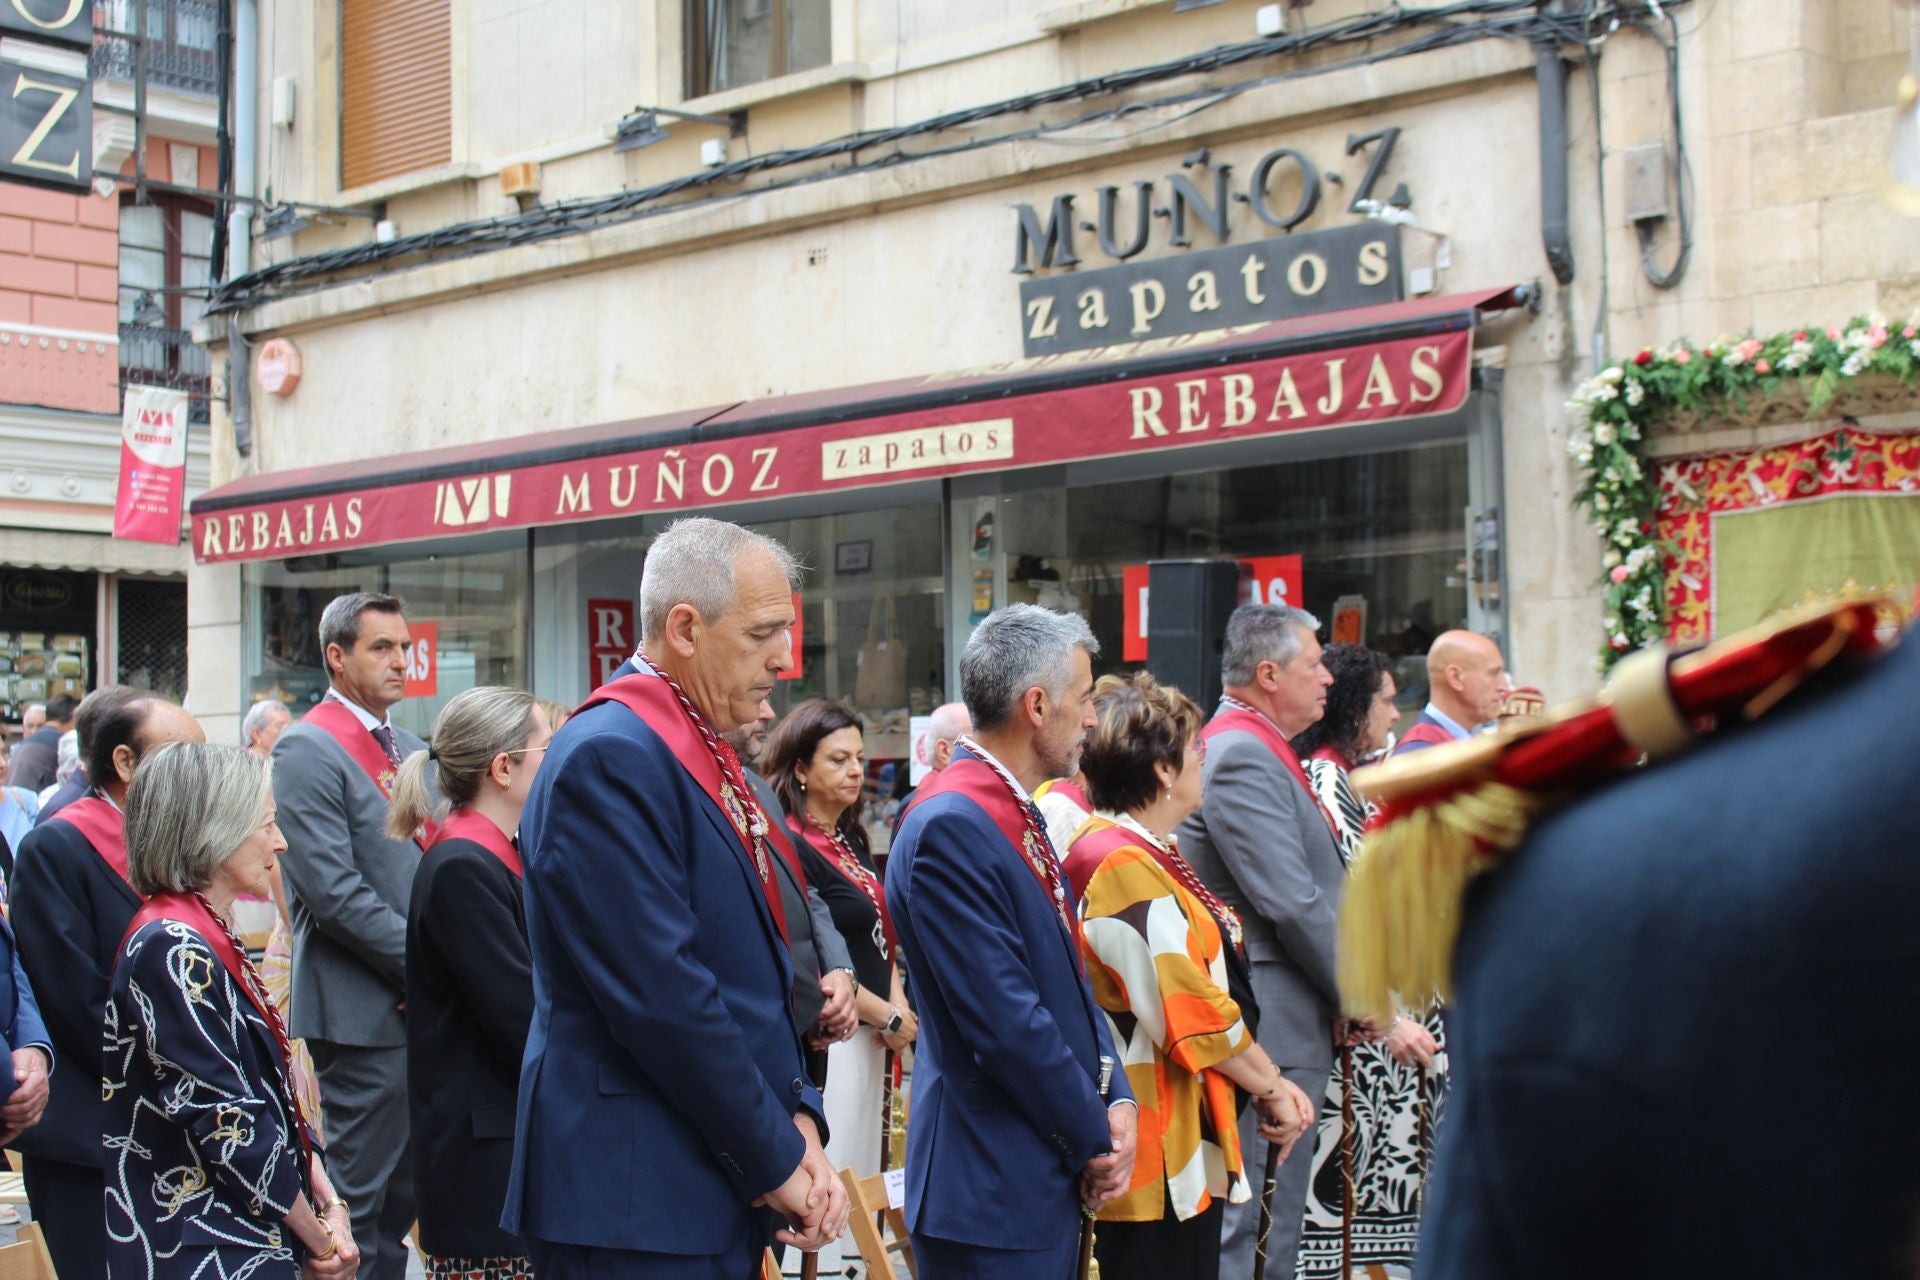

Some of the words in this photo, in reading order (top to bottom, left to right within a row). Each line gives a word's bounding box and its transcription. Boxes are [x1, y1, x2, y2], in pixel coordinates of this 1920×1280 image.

[1028, 240, 1389, 339] zapatos
[1129, 344, 1443, 440] REBAJAS
[202, 498, 363, 556] REBAJAS
[555, 446, 780, 516] MUÑOZ
[834, 428, 999, 470] zapatos
